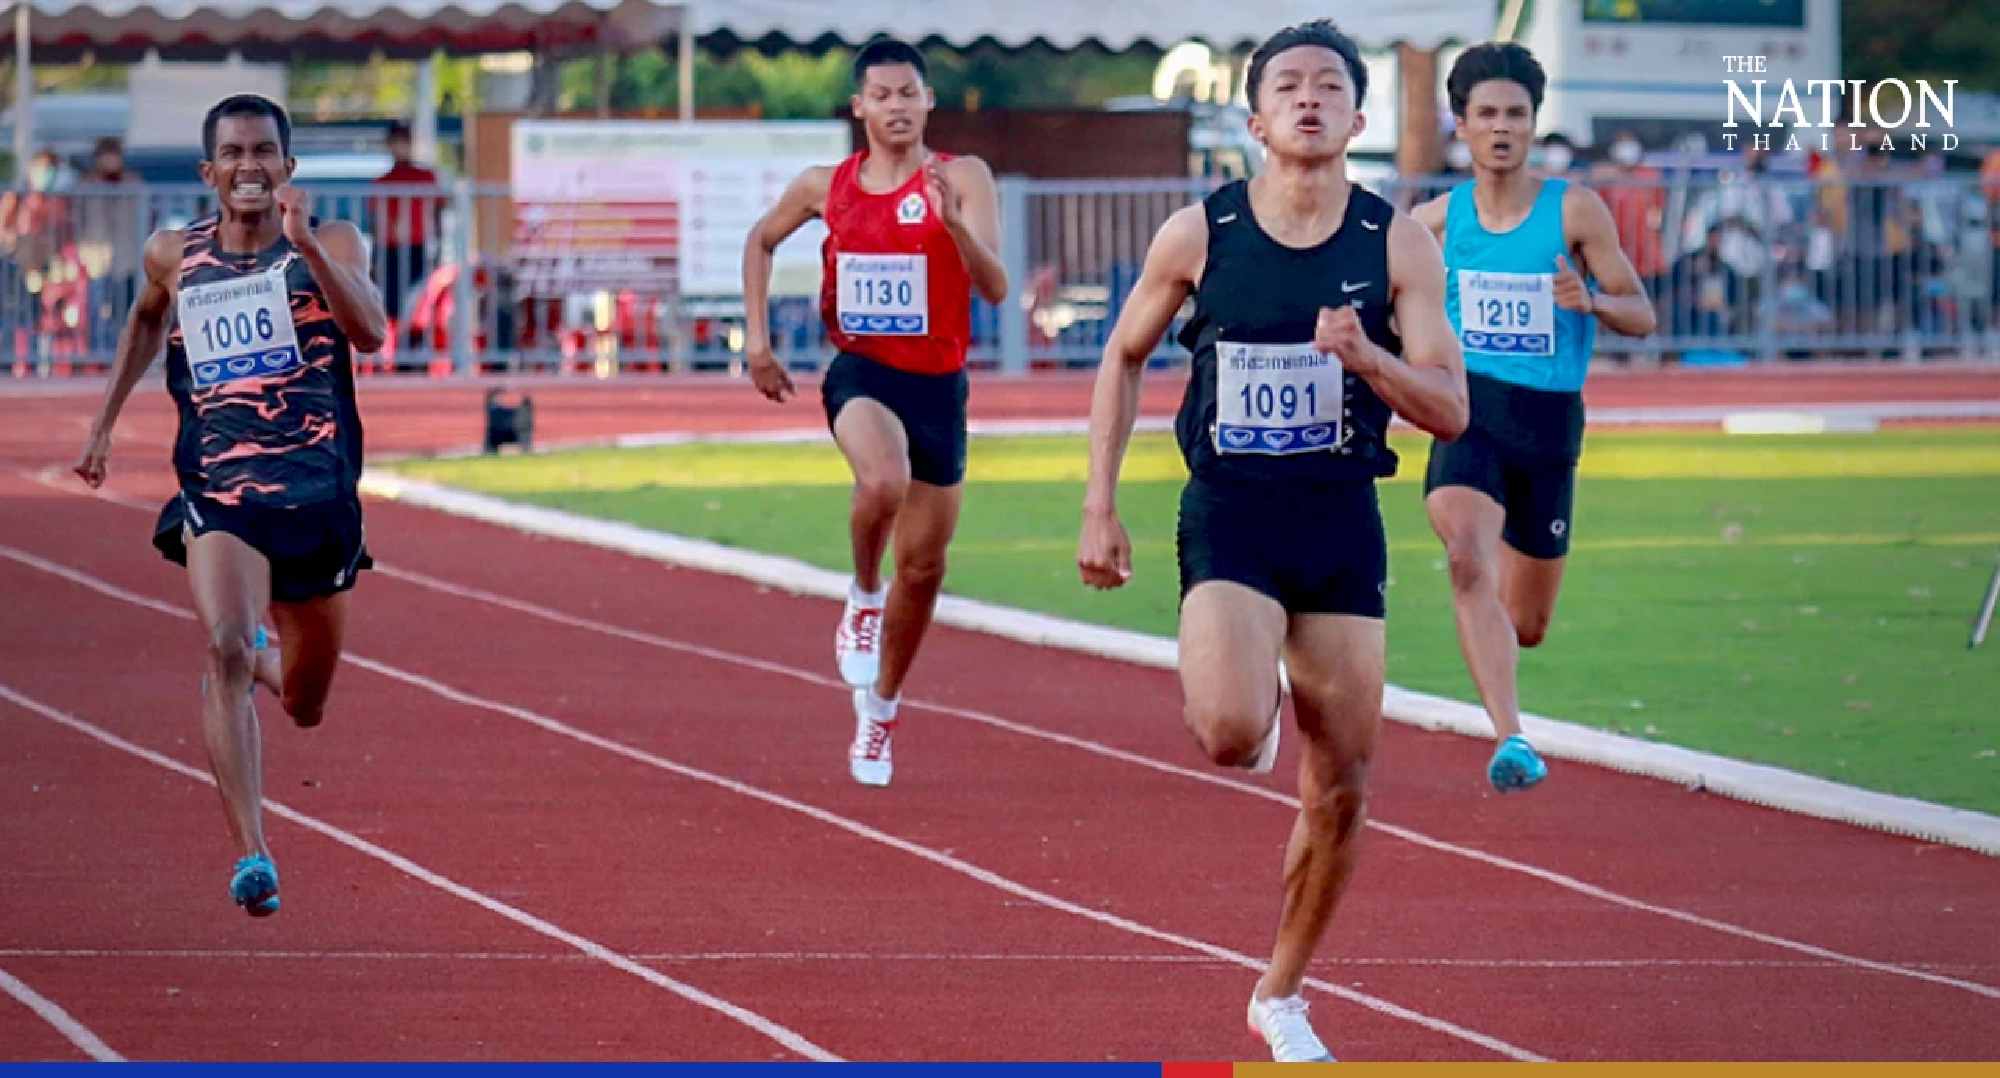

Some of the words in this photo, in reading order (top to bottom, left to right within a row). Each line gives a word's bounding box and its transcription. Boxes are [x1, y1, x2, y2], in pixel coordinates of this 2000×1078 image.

[853, 279, 912, 306] 1130
[1477, 298, 1530, 327] 1219
[201, 307, 274, 352] 1006
[1240, 382, 1317, 420] 1091
